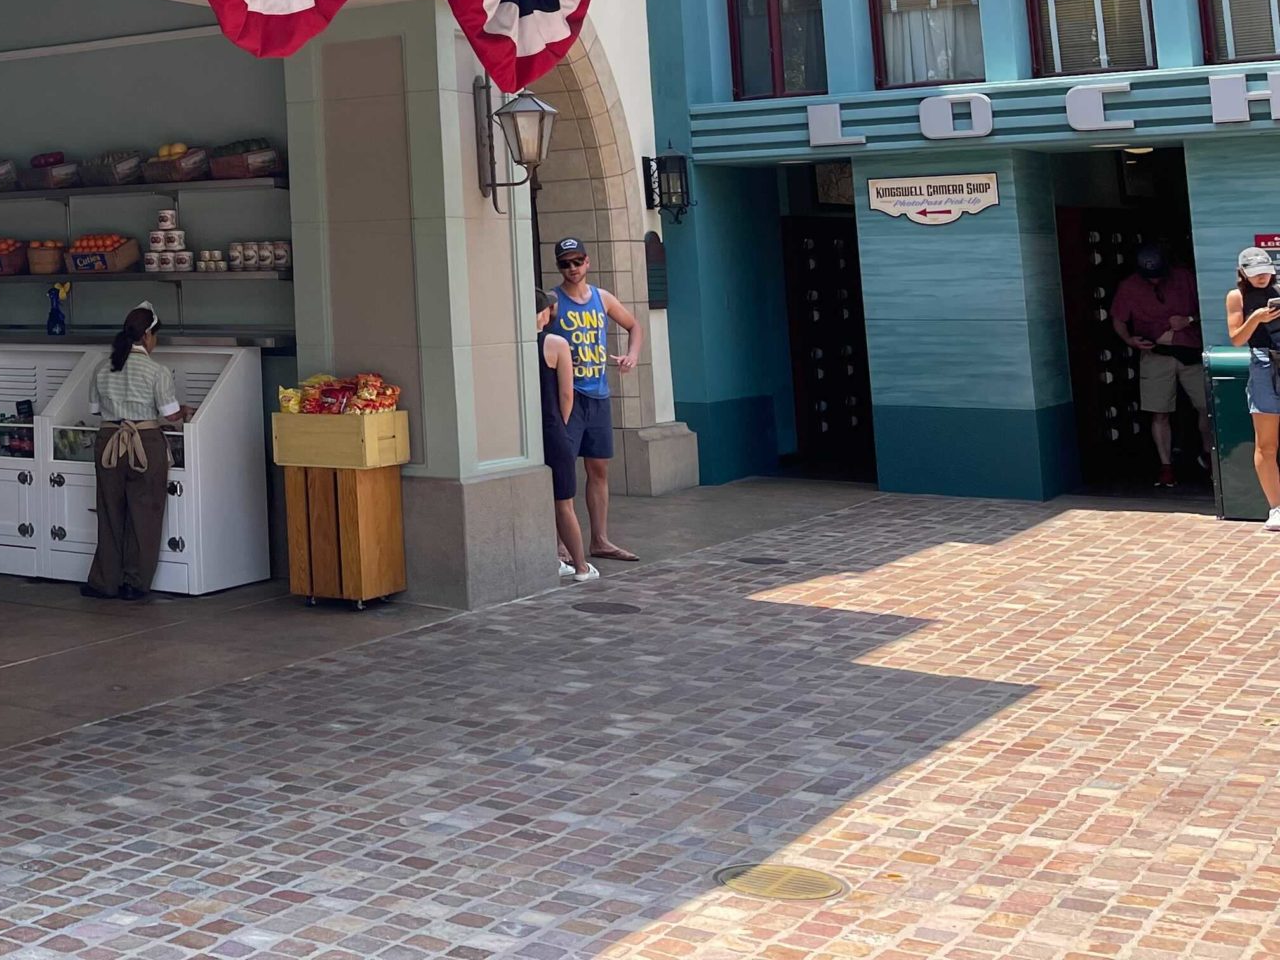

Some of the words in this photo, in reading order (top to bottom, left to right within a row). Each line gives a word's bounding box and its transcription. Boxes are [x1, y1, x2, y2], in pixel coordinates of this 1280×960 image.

[875, 186, 924, 199] KINGSWELL
[926, 184, 965, 196] CAMERA
[966, 182, 991, 195] SHOP
[560, 309, 604, 331] SUNS
[572, 330, 602, 344] OUT!
